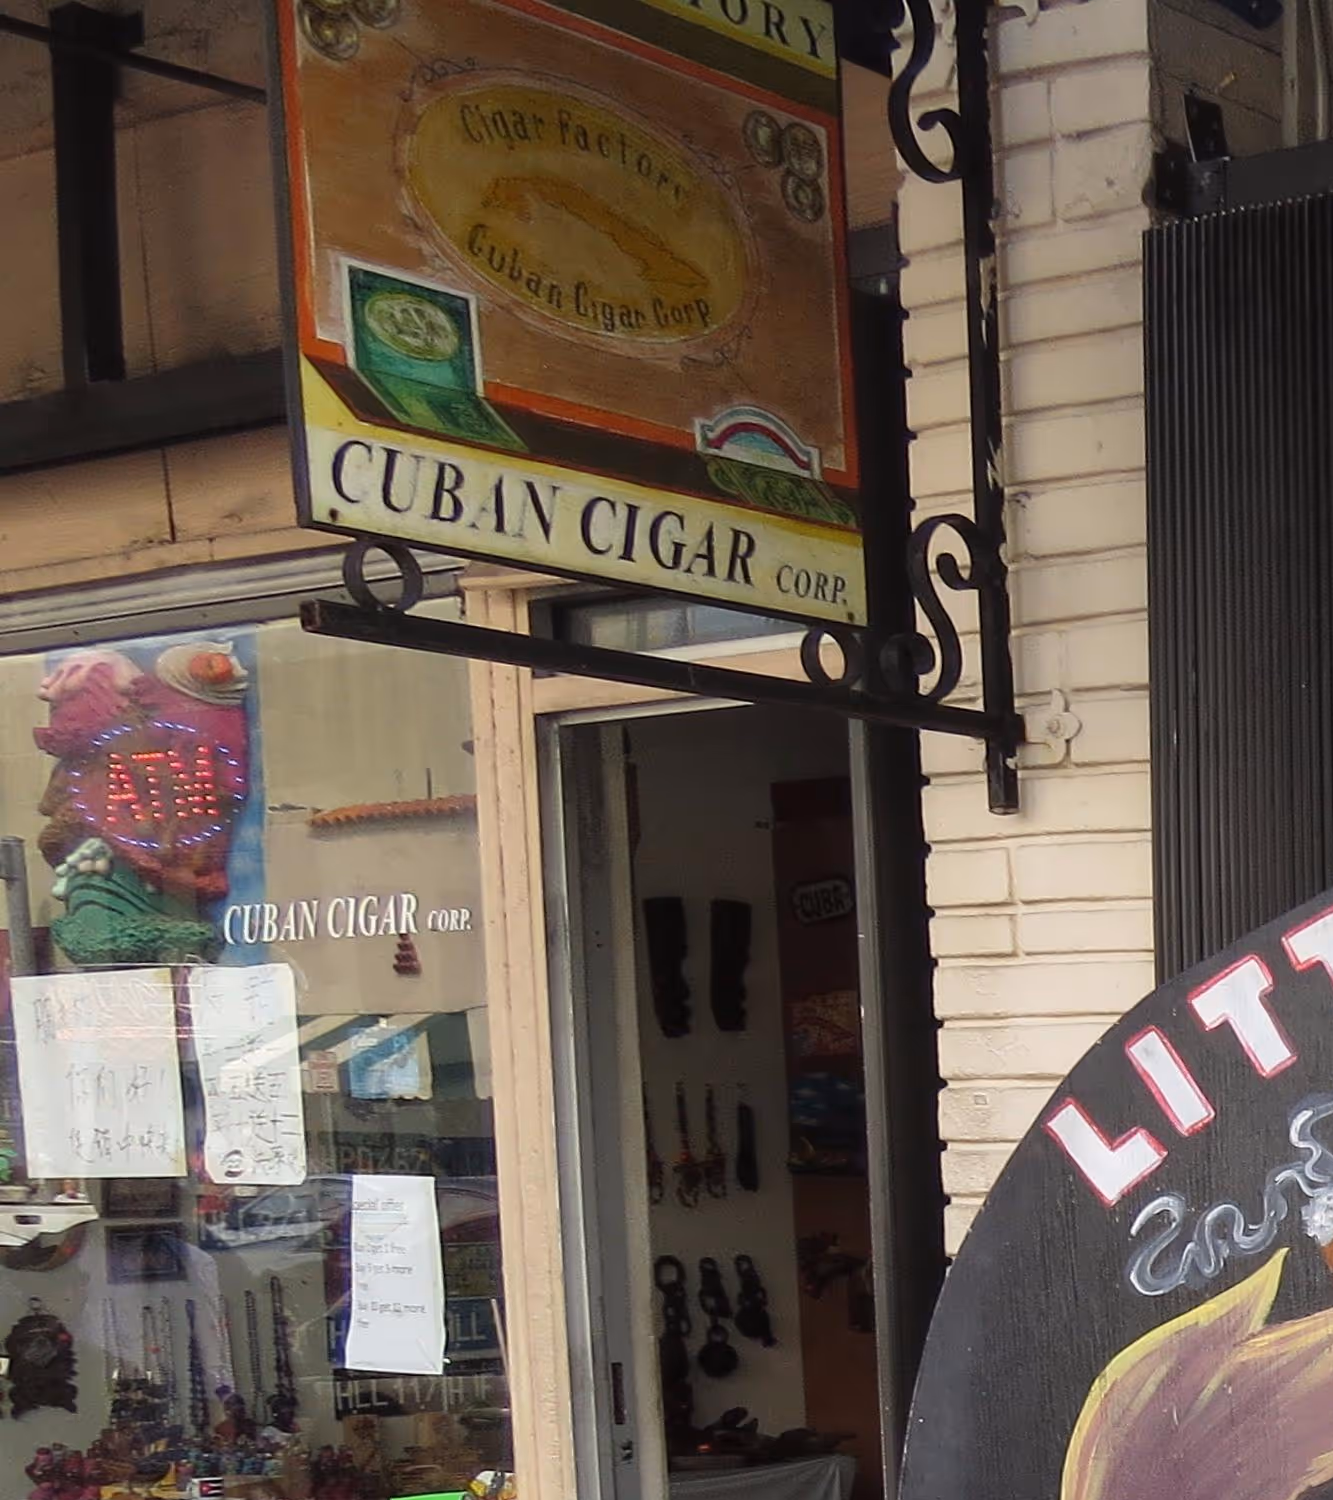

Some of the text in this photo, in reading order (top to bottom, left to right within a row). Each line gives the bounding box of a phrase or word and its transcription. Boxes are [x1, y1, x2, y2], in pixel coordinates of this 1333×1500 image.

[459, 103, 546, 150] Cigar
[466, 224, 712, 333] Cuban Cigar Corp
[330, 437, 848, 607] CUBAN CIGAR CORP.
[106, 746, 220, 822] ATM
[224, 892, 472, 945] CUBAN CIGAR CORP.
